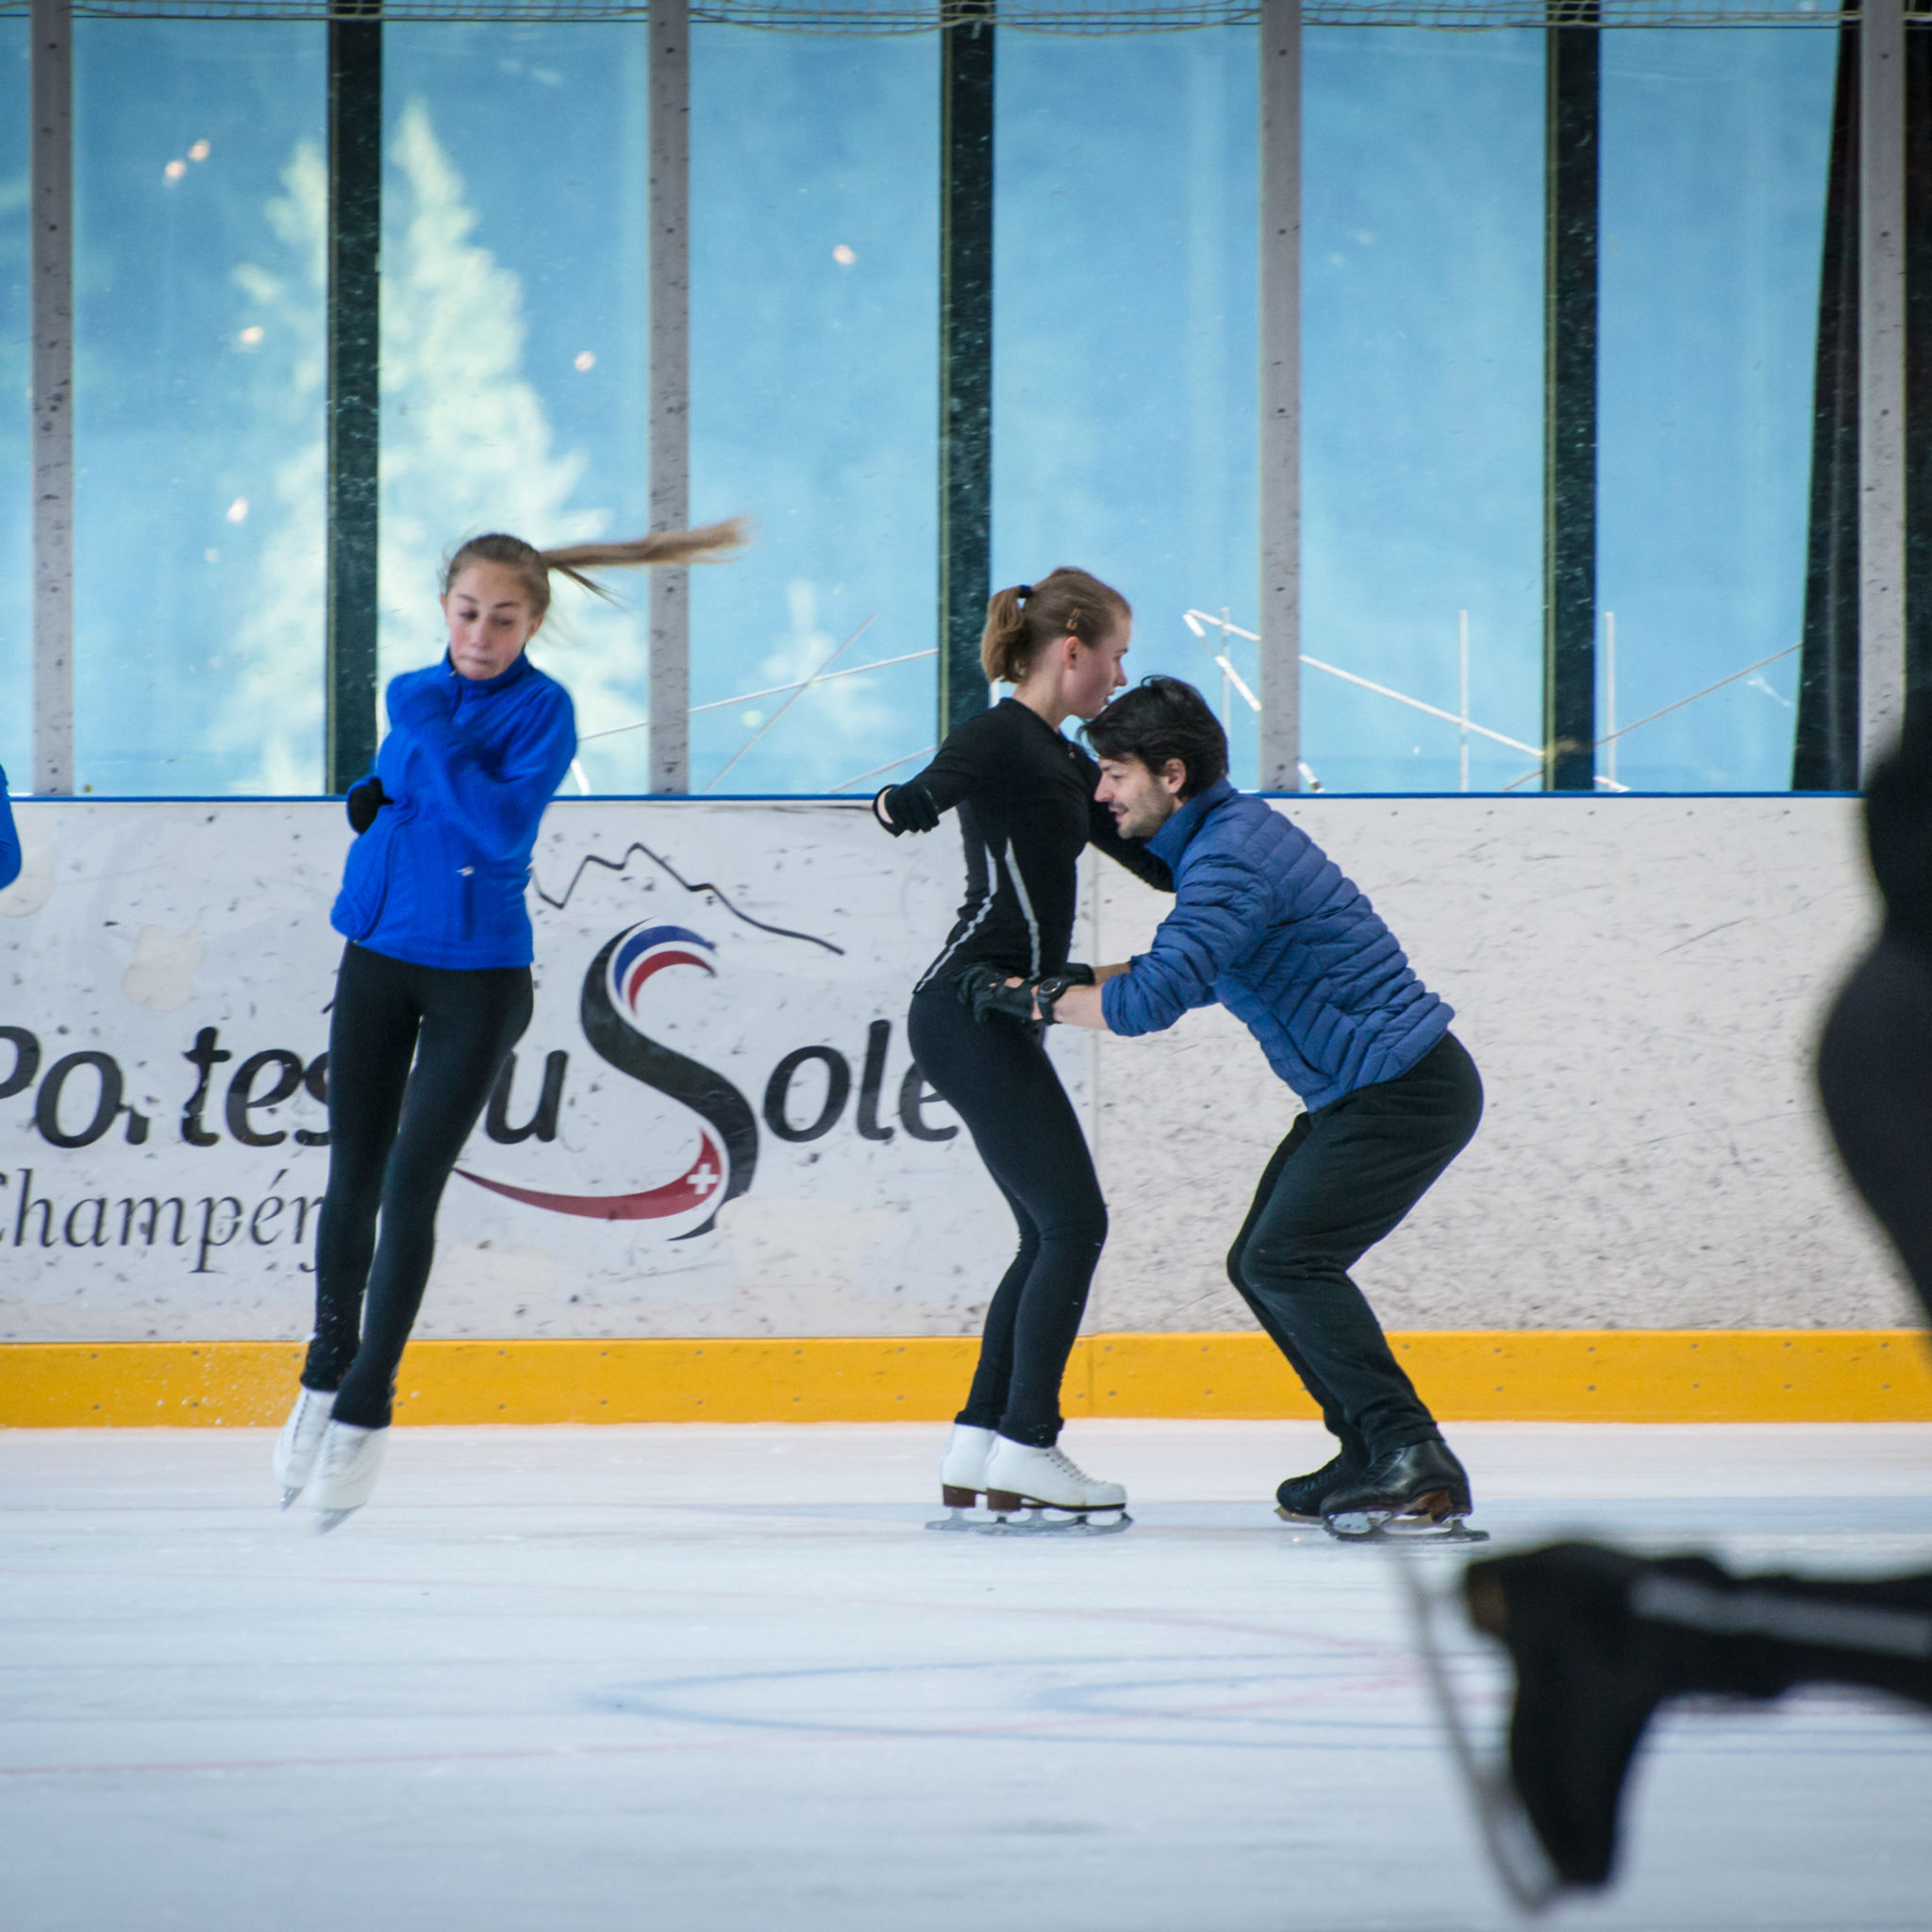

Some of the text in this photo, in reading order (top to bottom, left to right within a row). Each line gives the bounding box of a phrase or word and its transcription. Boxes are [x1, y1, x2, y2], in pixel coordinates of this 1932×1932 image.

[485, 1049, 570, 1144] u
[580, 916, 959, 1241] Sole
[0, 1168, 325, 1274] hampér
